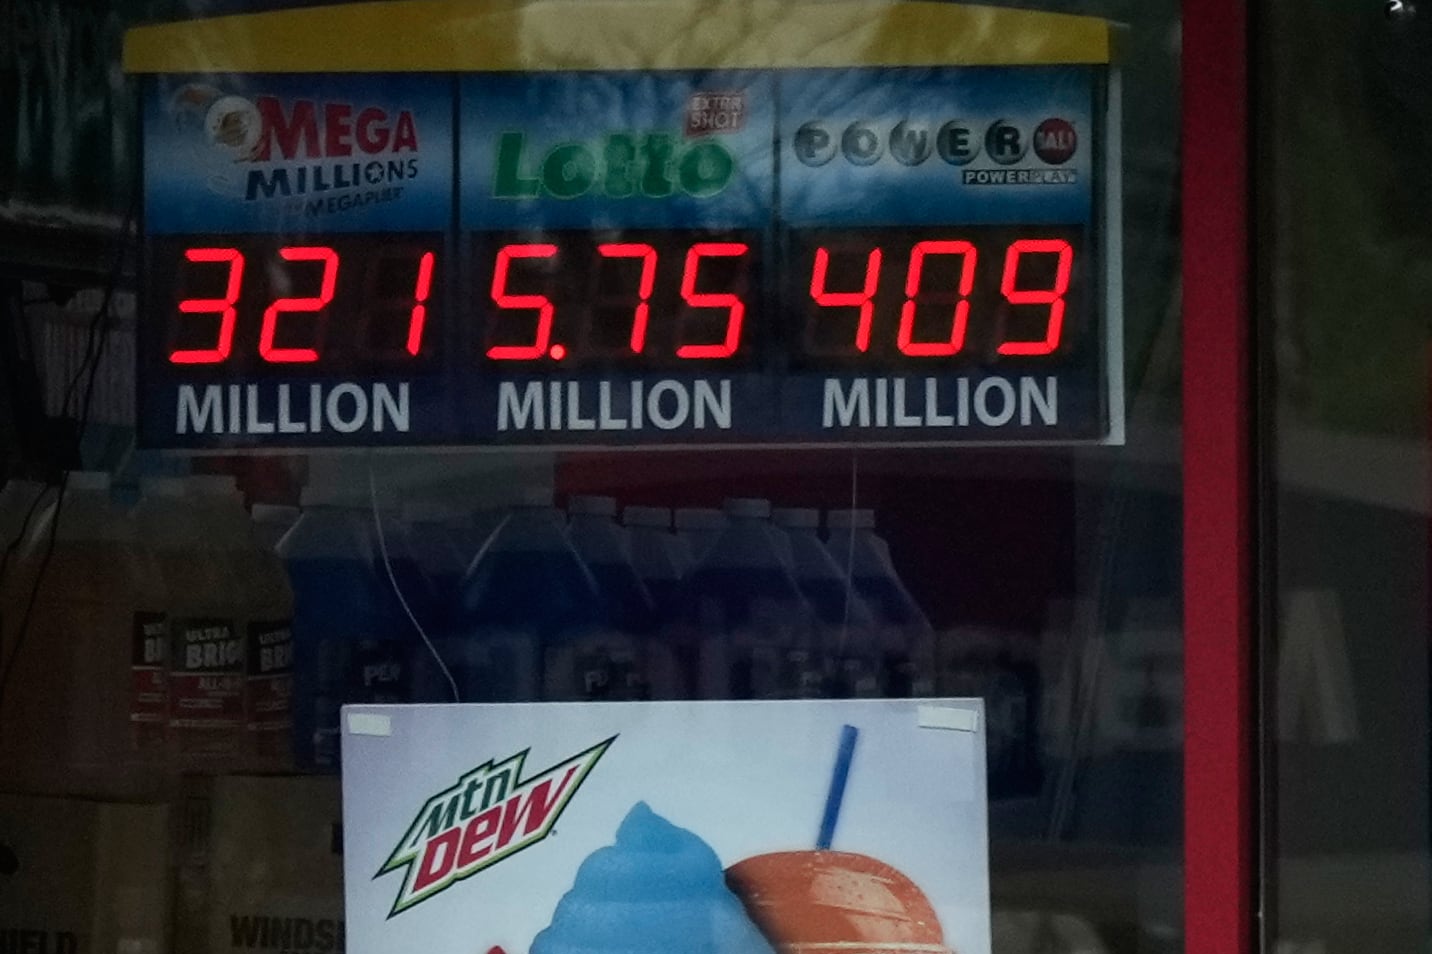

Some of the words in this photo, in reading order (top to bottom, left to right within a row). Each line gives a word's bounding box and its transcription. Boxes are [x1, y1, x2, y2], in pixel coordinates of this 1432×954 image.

[255, 96, 418, 161] MEGA
[245, 158, 418, 200] MILLIONS
[494, 130, 734, 198] Lotto
[169, 246, 434, 363] 321
[485, 243, 749, 361] 5.75
[809, 239, 1073, 356] 409
[176, 382, 410, 434] MILLION
[497, 379, 733, 431] MILLION
[822, 376, 1059, 428] MILLION
[410, 768, 512, 850] Mtn
